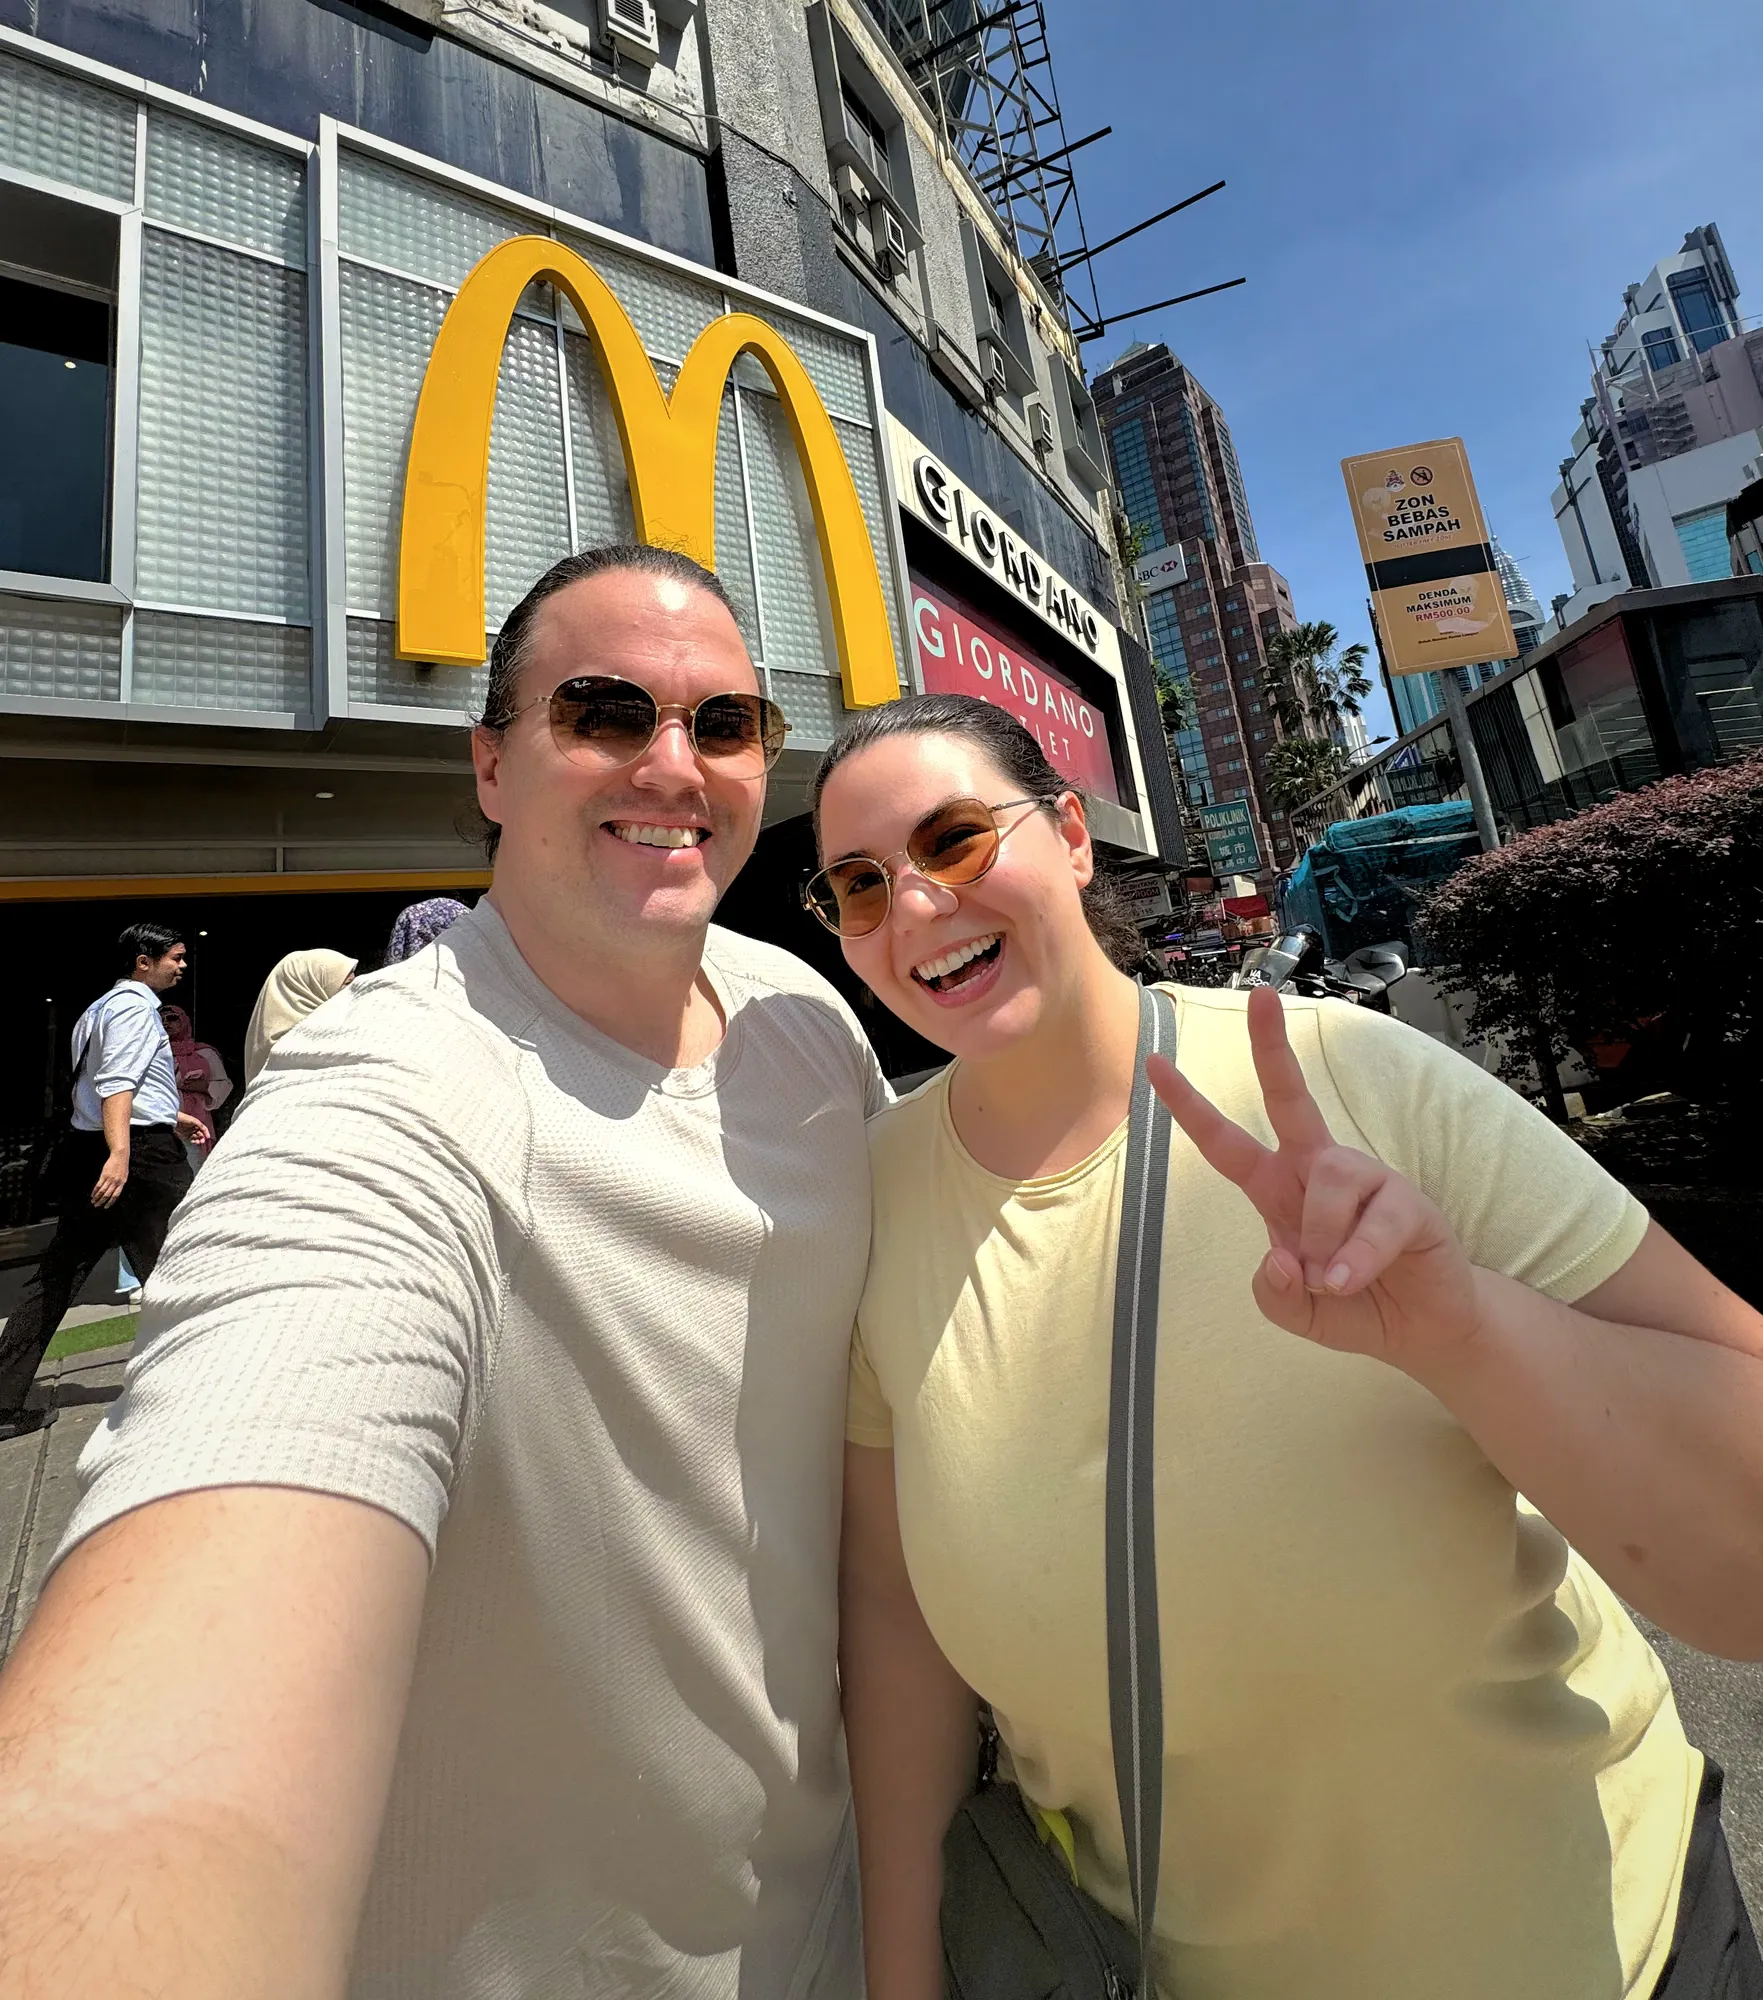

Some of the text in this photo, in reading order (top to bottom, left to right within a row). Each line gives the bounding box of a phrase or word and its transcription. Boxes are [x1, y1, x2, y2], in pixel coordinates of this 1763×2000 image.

[1395, 494, 1435, 511] ZON
[1388, 506, 1450, 527] BEBAS
[1383, 519, 1461, 542] SAMPAH
[913, 455, 1100, 646] GIORDANO
[1137, 566, 1160, 582] SBC
[1406, 596, 1471, 613] MAKSIMUM
[1418, 588, 1458, 601] DENDA
[1415, 606, 1470, 622] RM500.00
[913, 597, 1094, 738] GIORDANO
[979, 695, 1070, 761] TLET
[1204, 808, 1247, 828] POLIKLINIK
